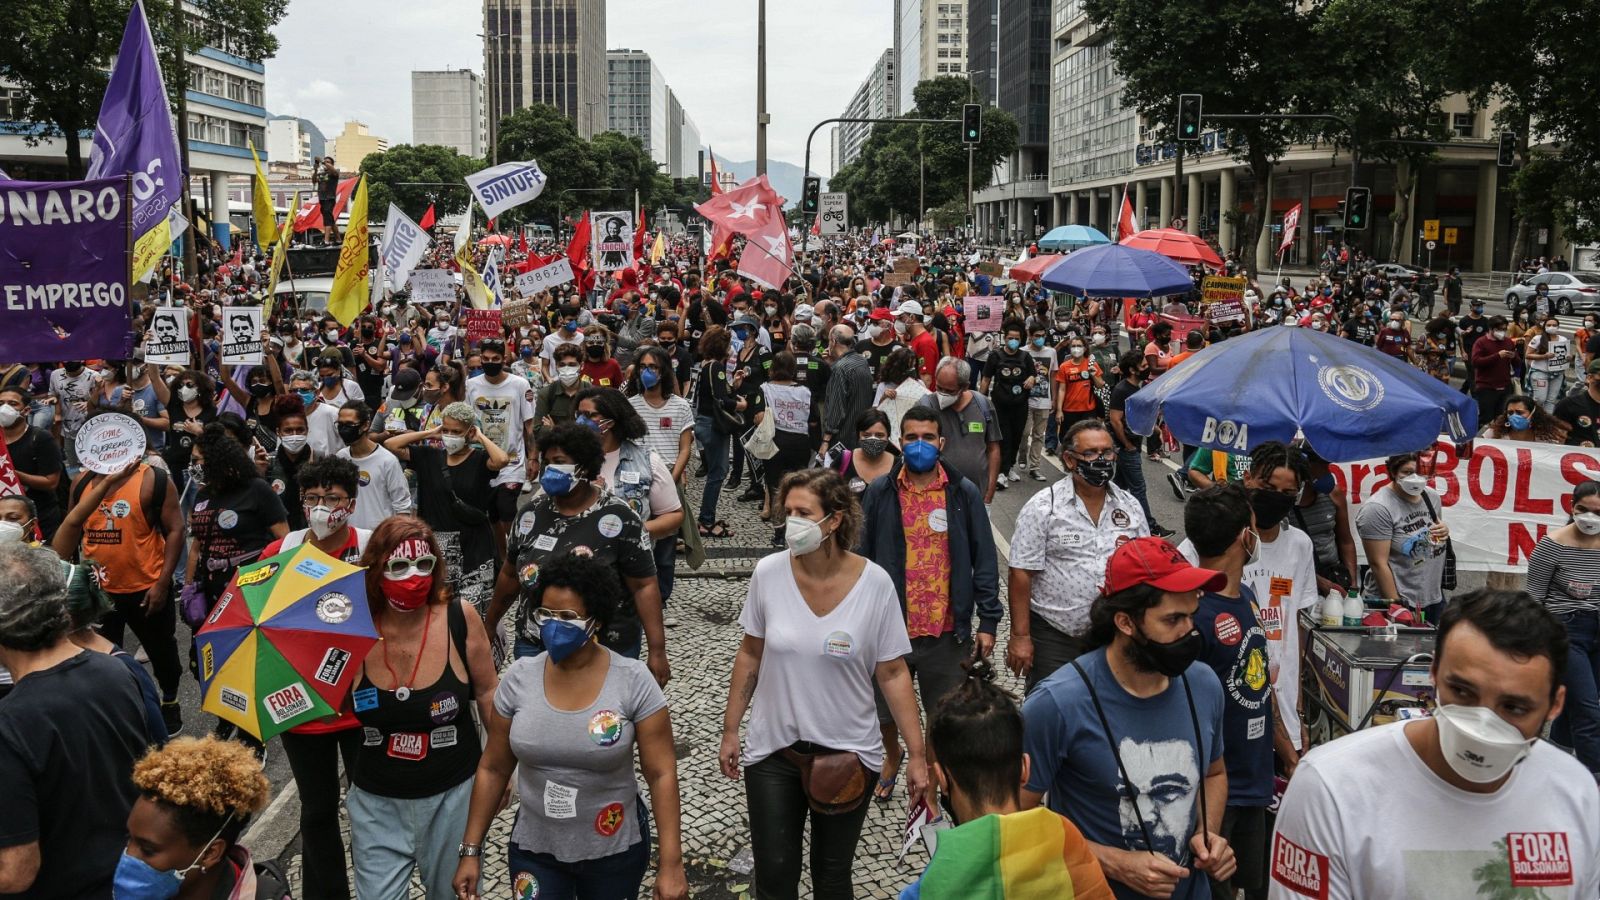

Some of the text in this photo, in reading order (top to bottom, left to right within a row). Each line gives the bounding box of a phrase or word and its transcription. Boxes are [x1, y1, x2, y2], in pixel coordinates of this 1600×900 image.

[476, 168, 543, 206] SINTUFF
[0, 186, 121, 226] NARO
[519, 263, 566, 288] 498621
[4, 282, 125, 310] EMPREGO
[485, 415, 506, 423] adidas
[1201, 416, 1248, 451] BOA
[90, 438, 133, 455] QUEREMOS
[1260, 608, 1279, 621] ORA
[320, 664, 334, 680] FORA
[1326, 657, 1343, 678] AÇAÍ
[267, 685, 304, 711] FORA
[276, 698, 307, 717] BOLSONARO
[431, 696, 456, 711] #FORA
[431, 703, 459, 717] BOLSONARO
[393, 744, 421, 755] BOLSONARO
[394, 734, 422, 749] FORA
[1464, 750, 1484, 763] 3M
[1510, 833, 1569, 862] FORA
[1278, 837, 1321, 880] FORA
[1513, 861, 1569, 874] BOLSONARO
[1276, 861, 1320, 891] BOLSONARO
